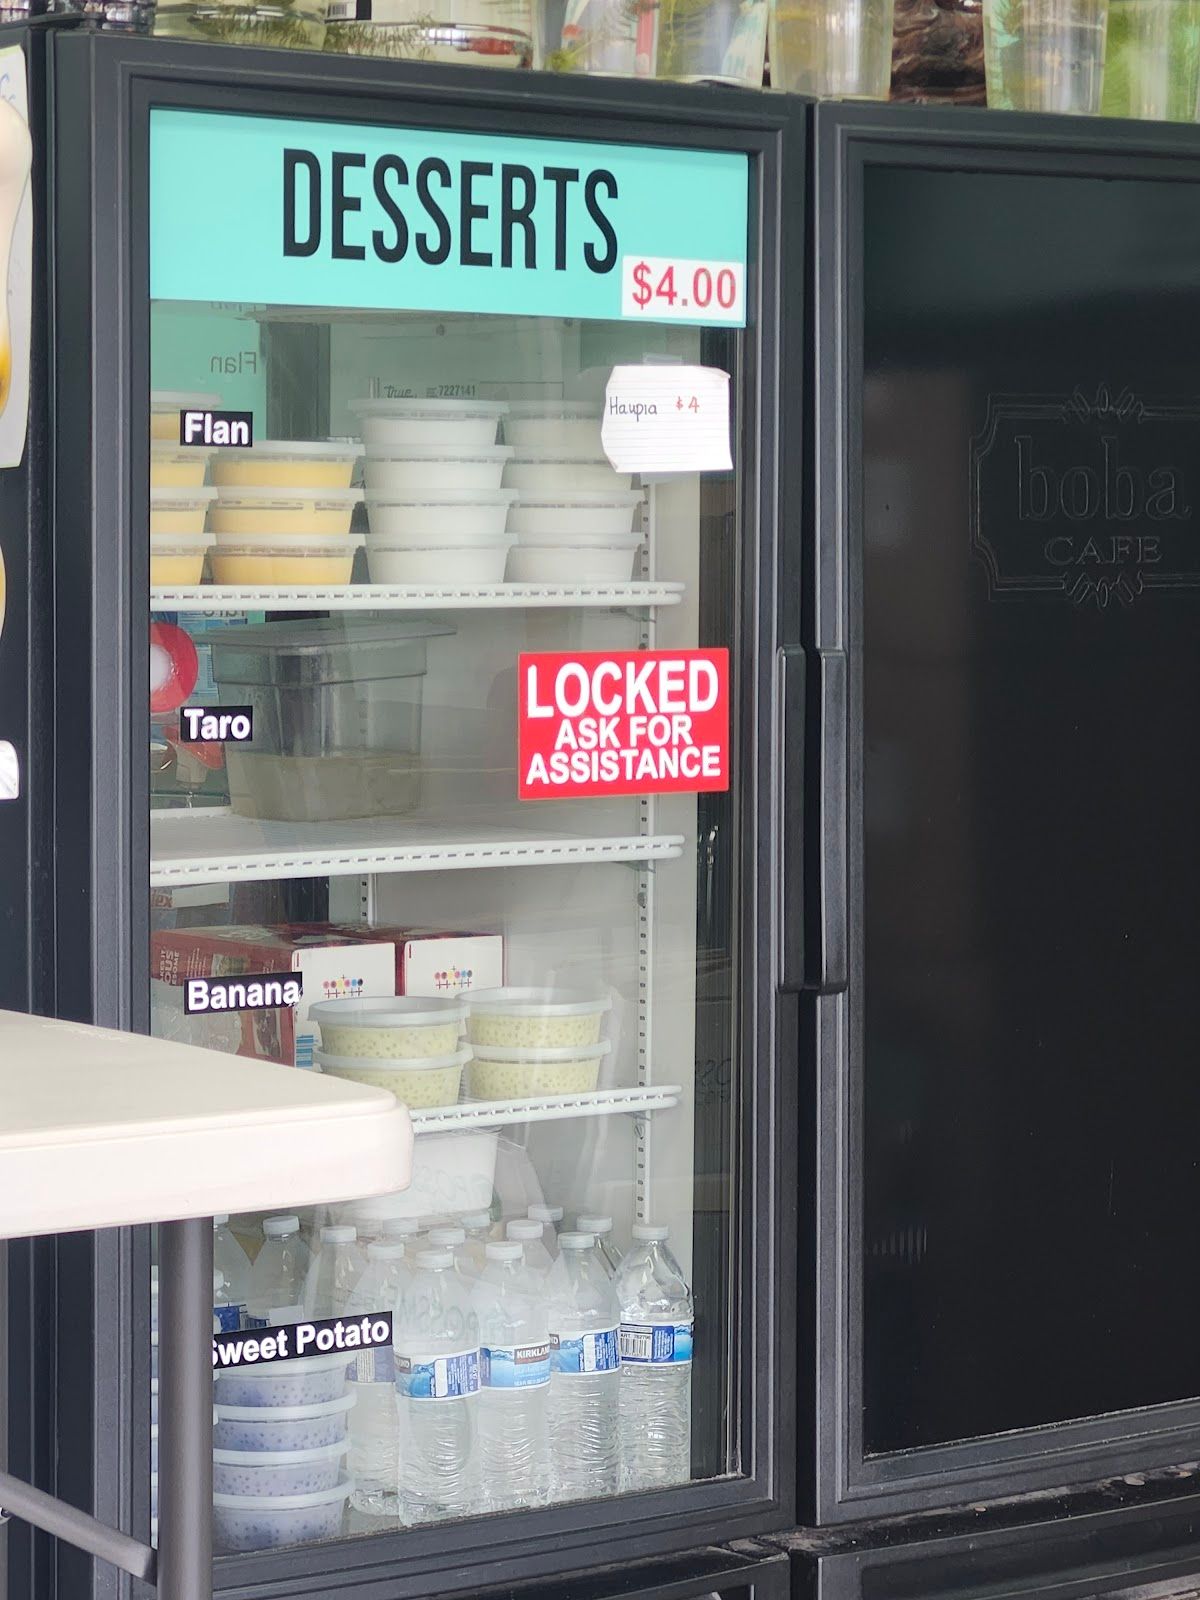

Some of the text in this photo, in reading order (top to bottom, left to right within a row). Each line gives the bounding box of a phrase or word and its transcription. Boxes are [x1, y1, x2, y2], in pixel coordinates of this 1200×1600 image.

[283, 148, 619, 274] DESSERTS
[632, 261, 737, 311] $4.00
[609, 396, 658, 422] Haupia
[184, 412, 250, 445] Flan
[1014, 435, 1193, 521] boba
[1044, 535, 1163, 566] CAFE
[527, 659, 720, 719] LOCKED
[184, 708, 251, 741] Taro
[554, 715, 694, 751] ASK FOR
[526, 745, 722, 785] ASSISTANCE
[187, 980, 301, 1012] Banana
[296, 1317, 390, 1354] Potato
